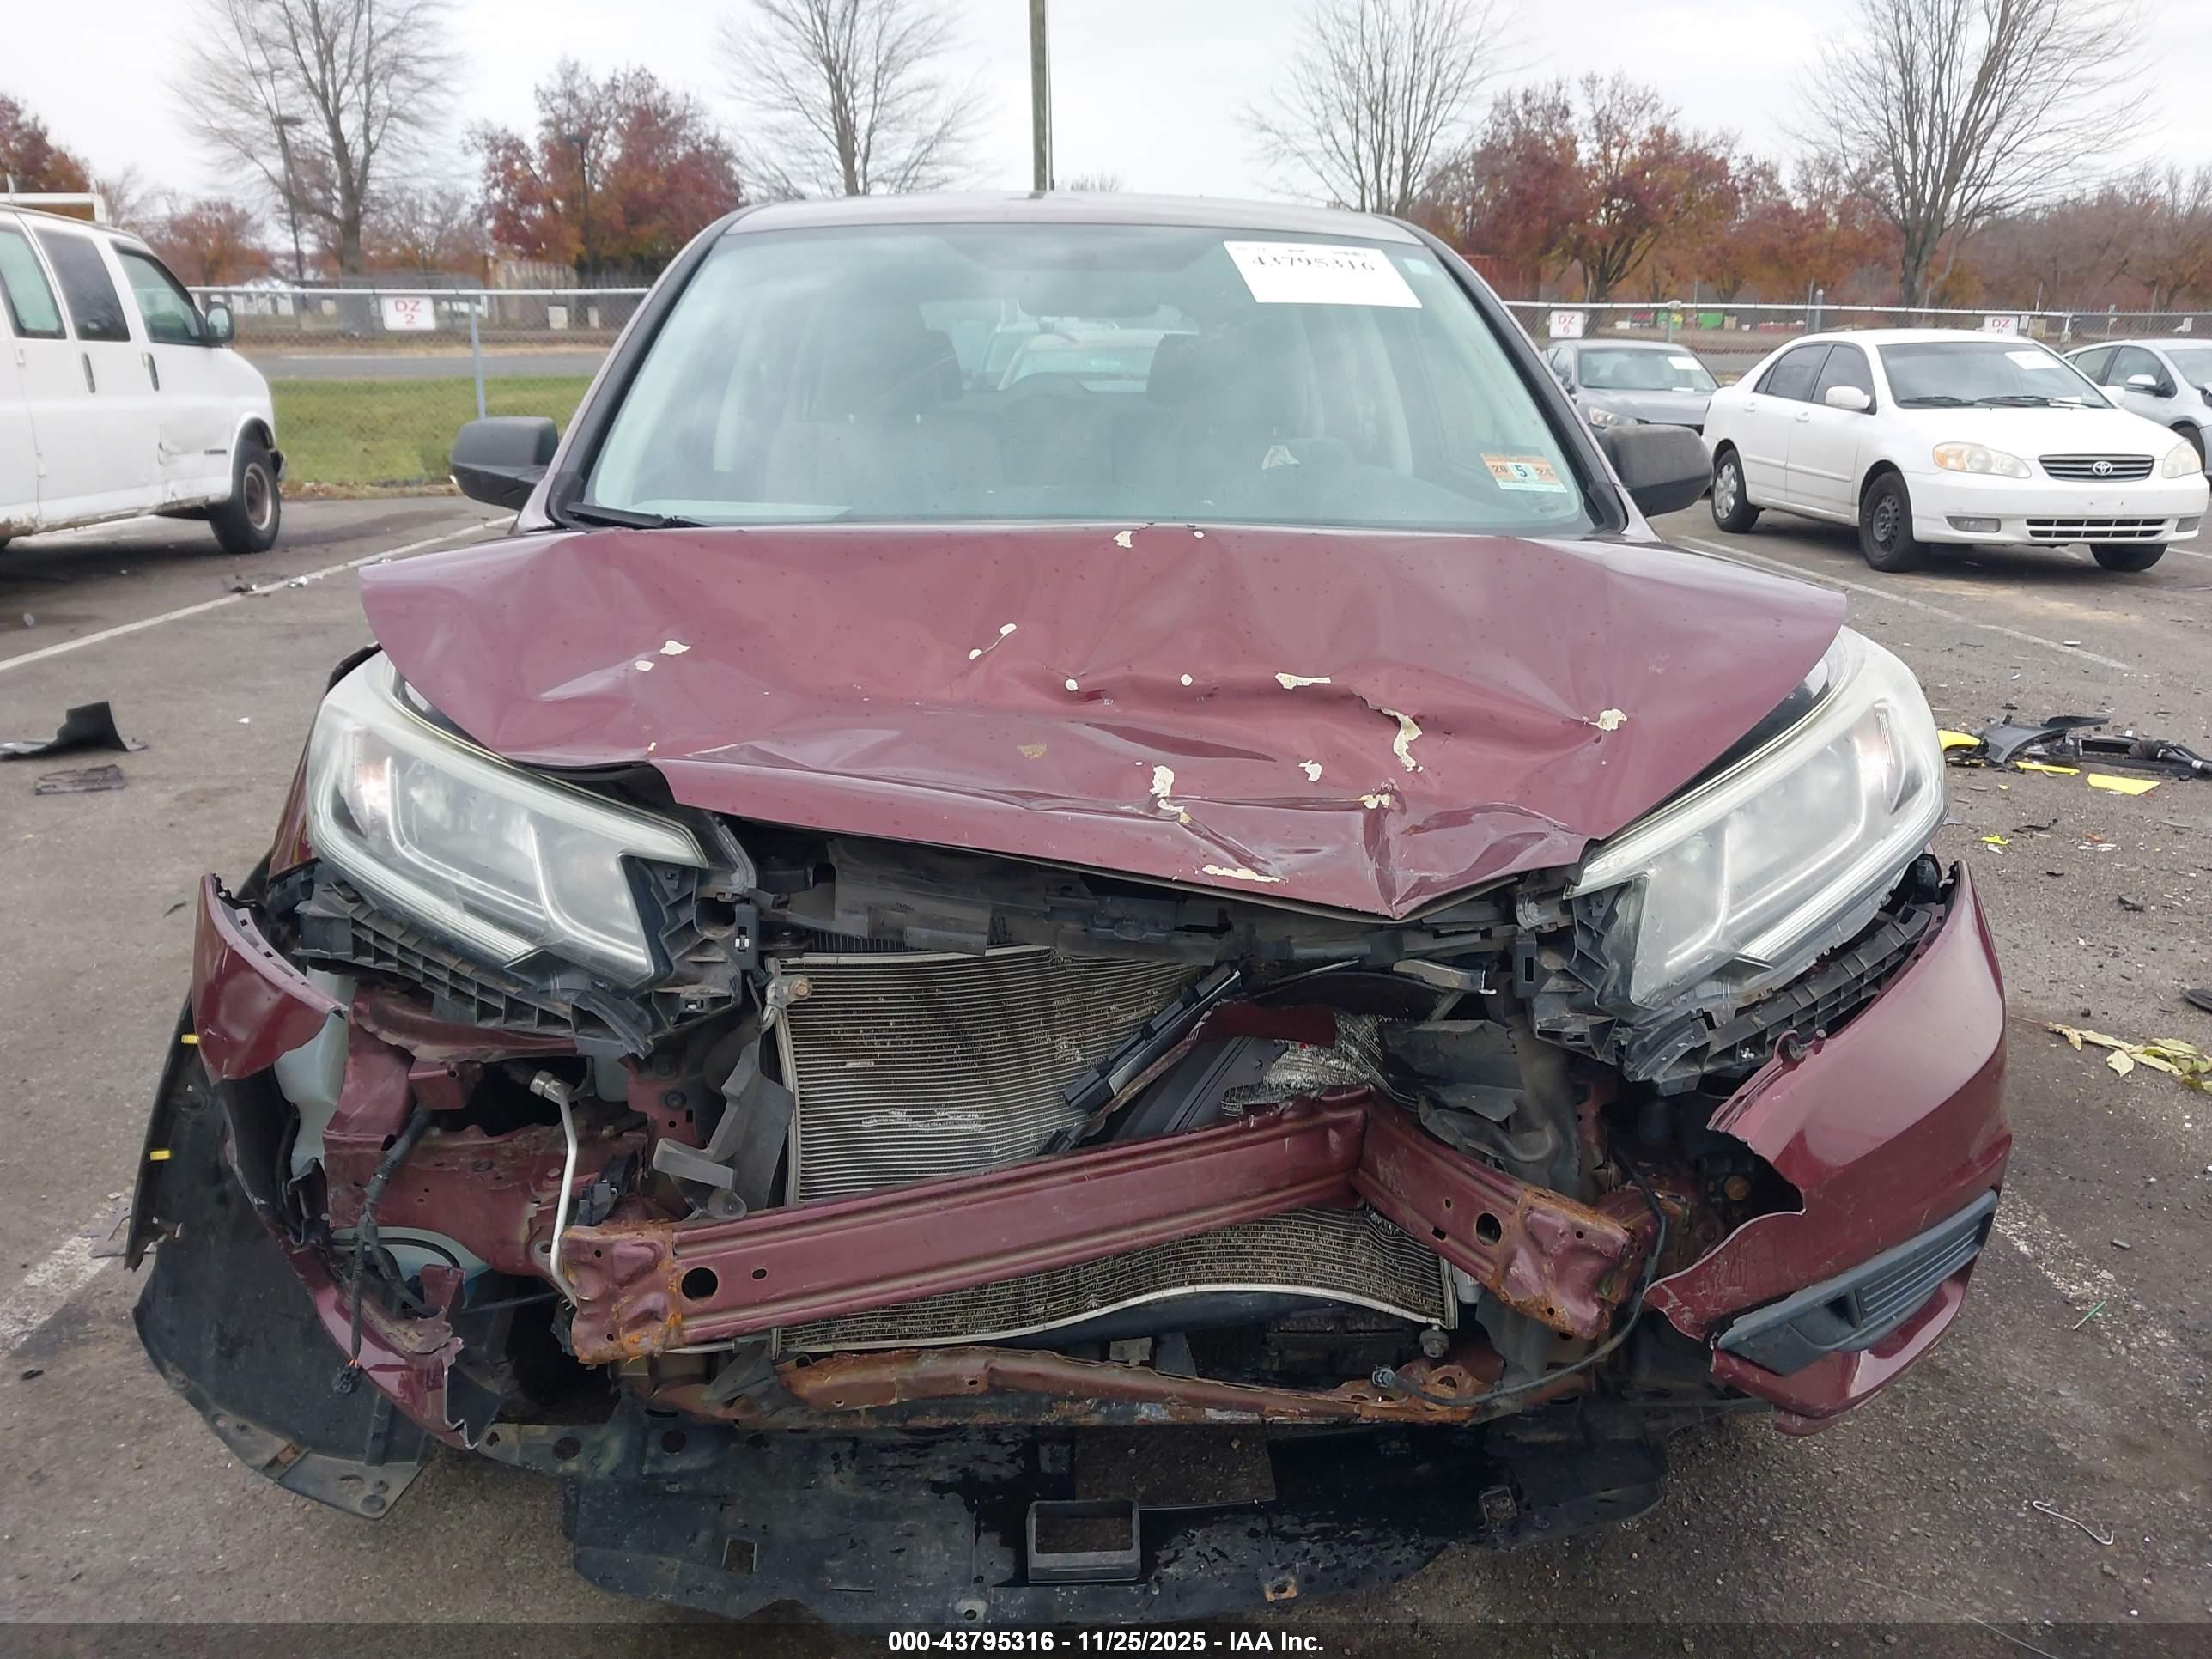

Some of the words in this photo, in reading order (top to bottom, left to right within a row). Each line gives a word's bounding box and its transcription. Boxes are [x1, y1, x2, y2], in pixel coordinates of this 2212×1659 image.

[1251, 256, 1376, 272] 43795316
[394, 300, 421, 312] DZ
[404, 313, 416, 324] 2
[1558, 314, 1577, 325] DZ
[1991, 318, 2010, 328] DZ
[1515, 465, 1528, 477] 5
